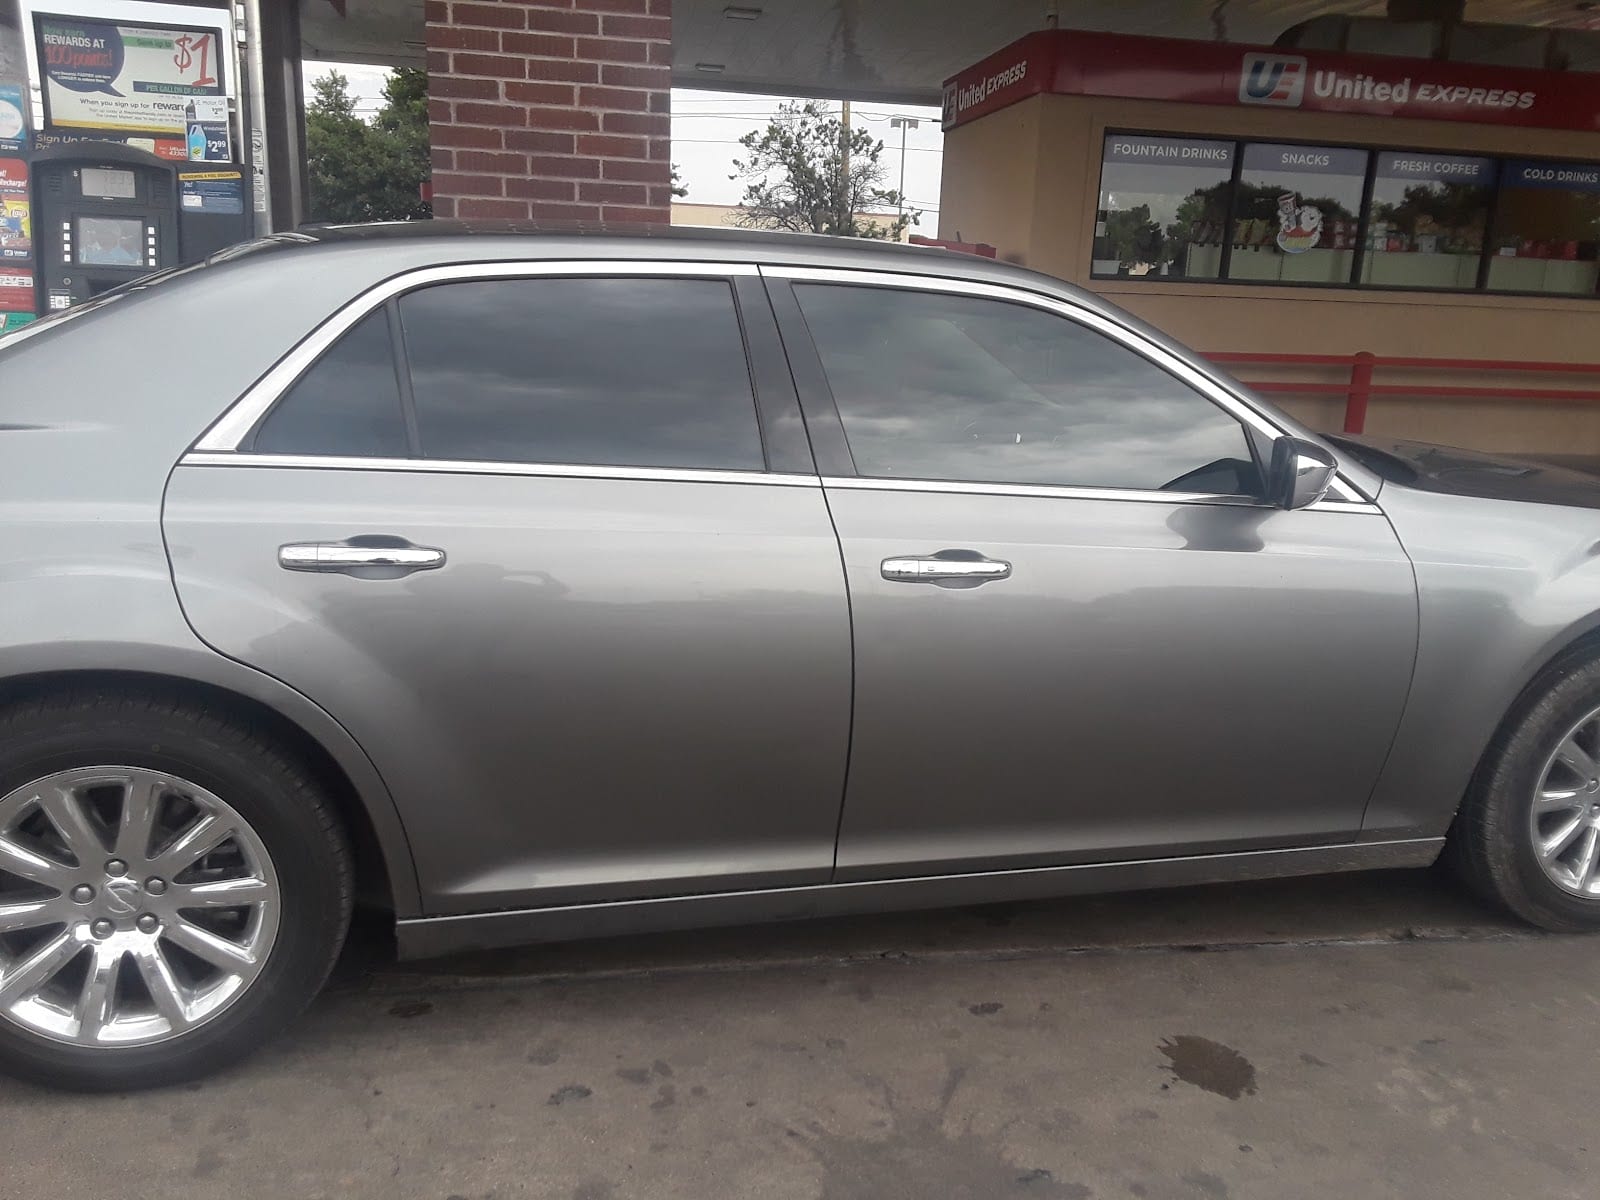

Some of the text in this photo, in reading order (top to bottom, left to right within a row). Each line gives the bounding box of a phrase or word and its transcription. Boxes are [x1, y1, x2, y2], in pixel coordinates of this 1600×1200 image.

[44, 33, 106, 49] REWARDS AT
[173, 33, 216, 87] $1
[958, 77, 986, 111] United
[986, 60, 1027, 95] EXPRESS
[1314, 70, 1411, 103] United
[1415, 84, 1536, 109] EXPRESS
[114, 100, 129, 109] sign
[130, 102, 140, 110] up
[152, 102, 185, 111] rewar
[36, 133, 60, 144] Sign
[1114, 143, 1229, 160] FOUNTAIN DRINKS
[1281, 152, 1330, 166] SNACKS
[1393, 160, 1479, 175] FRESH COFFEE
[1523, 168, 1599, 184] COLD DRINKS
